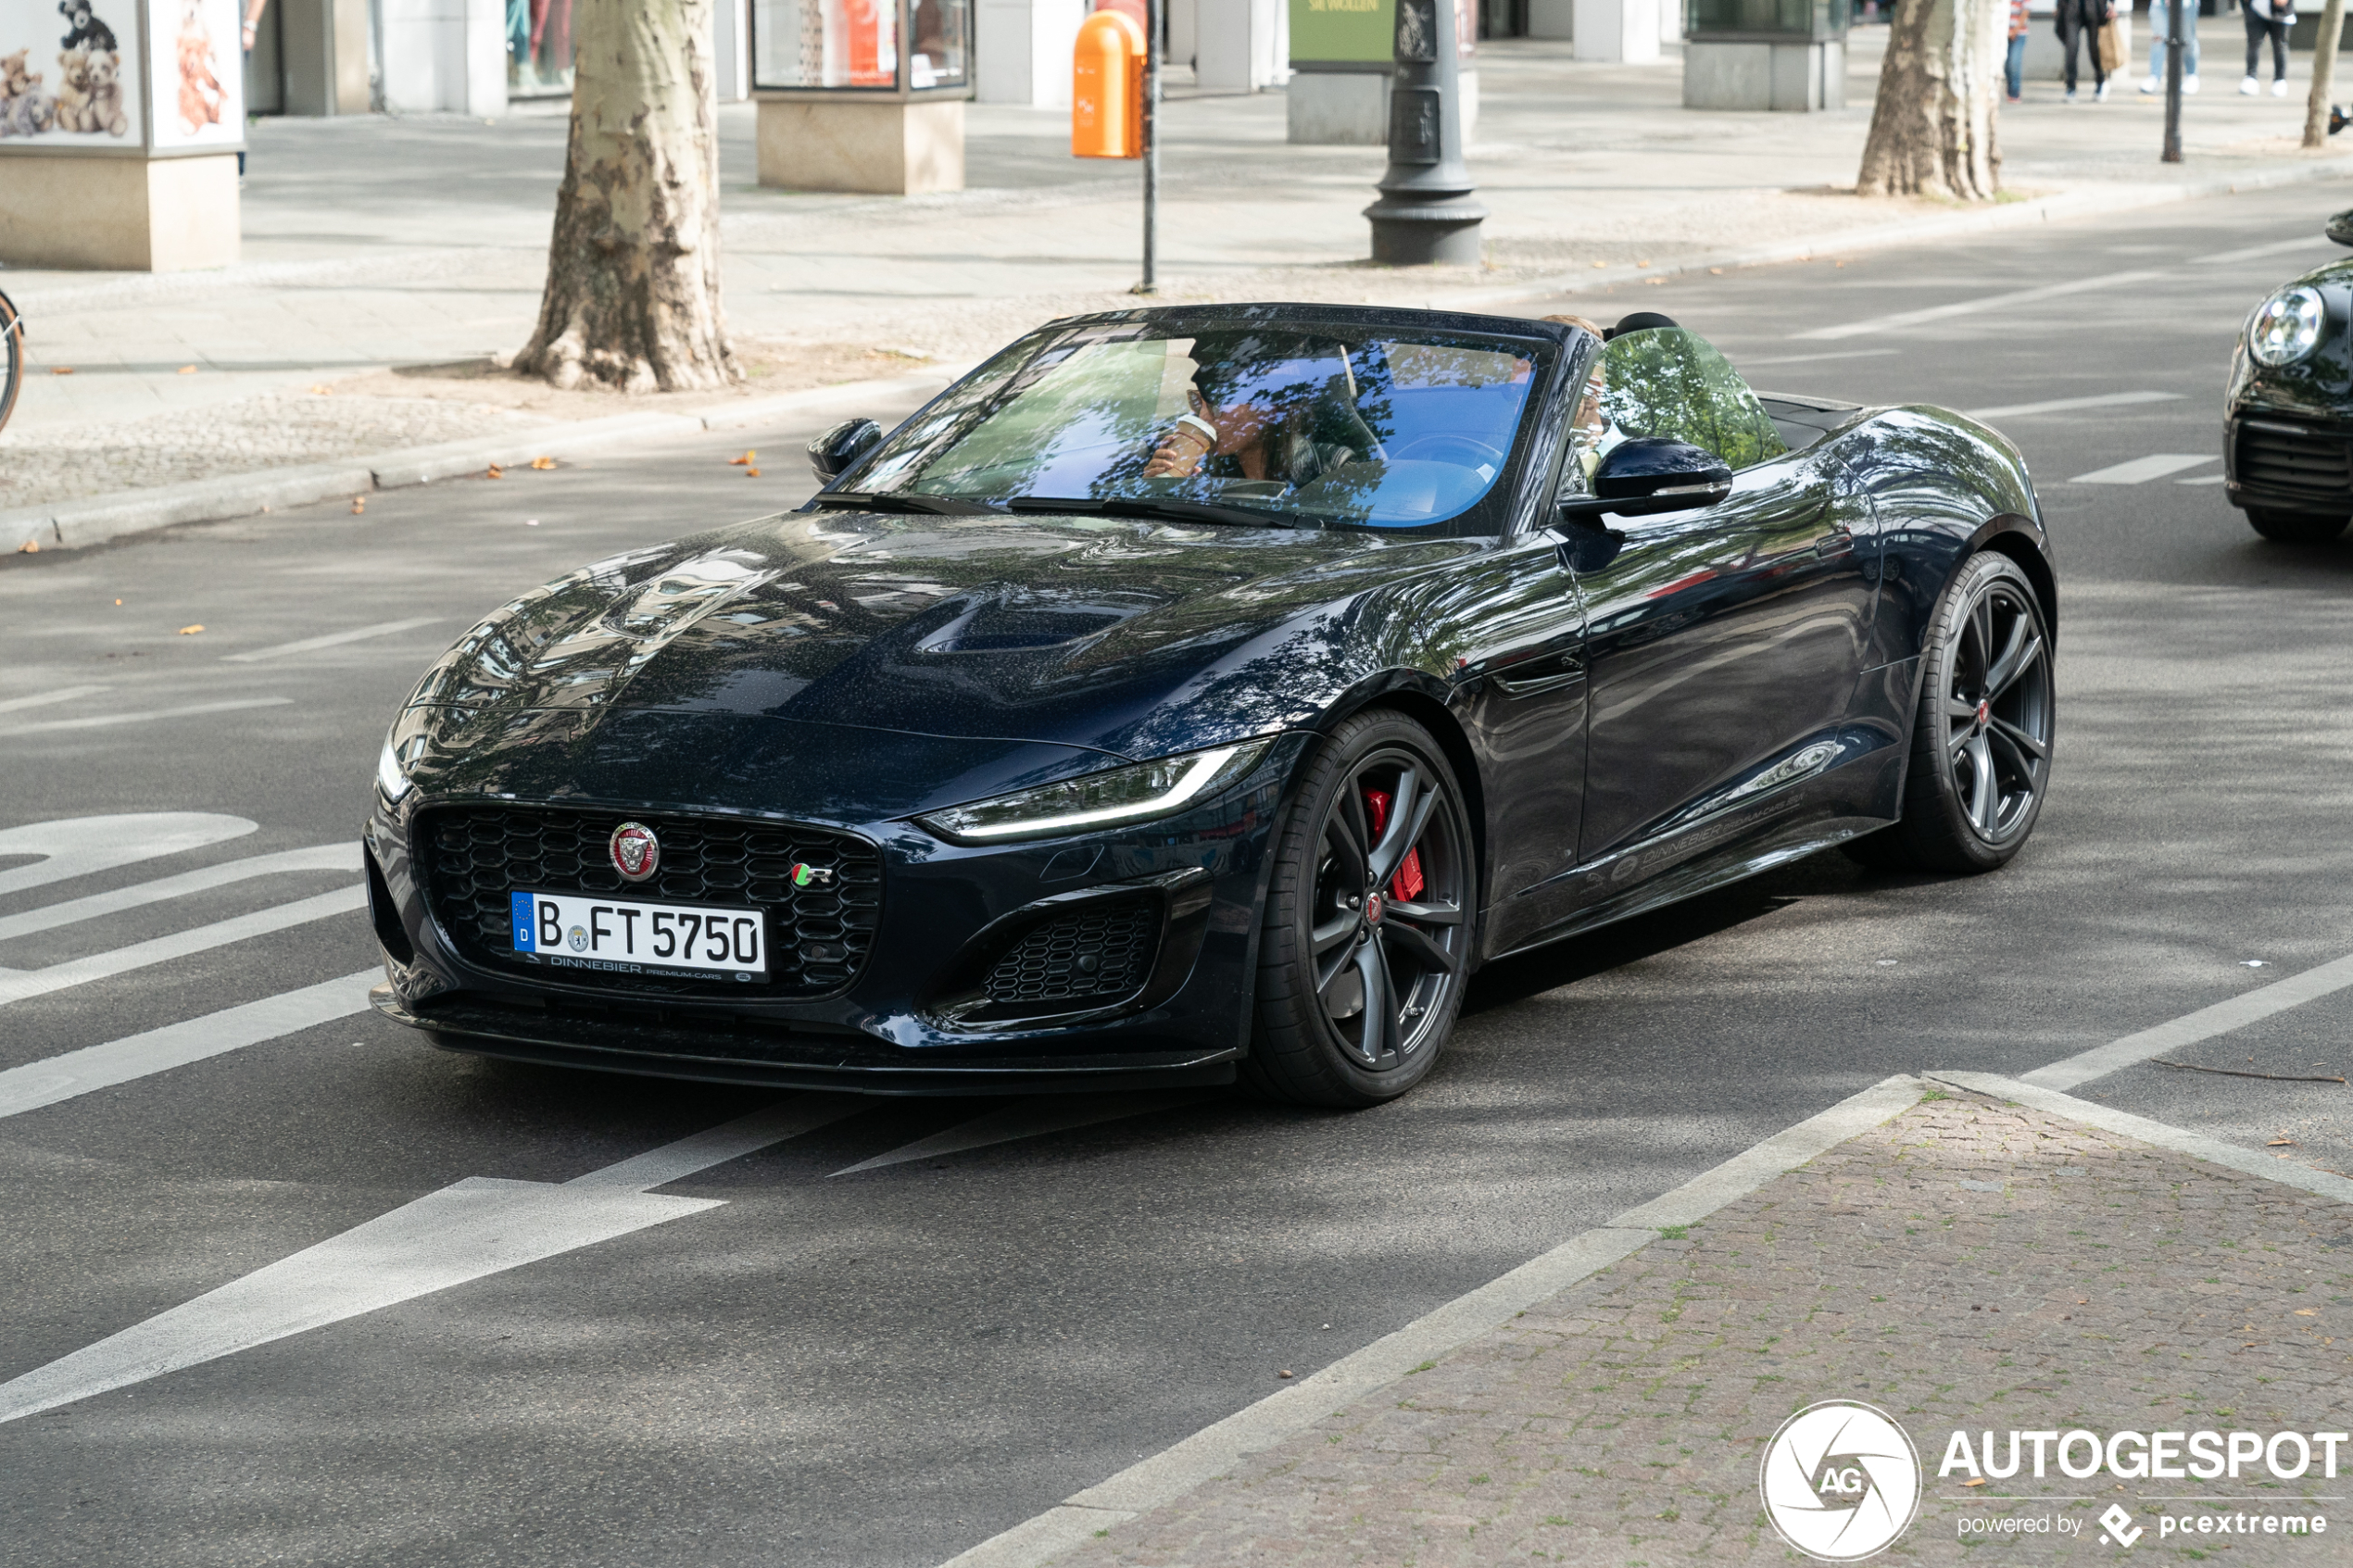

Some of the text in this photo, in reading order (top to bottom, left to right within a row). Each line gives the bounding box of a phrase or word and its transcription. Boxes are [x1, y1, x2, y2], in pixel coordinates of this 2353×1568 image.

[1642, 823, 1722, 864] DINNEBIER
[520, 928, 529, 942] D
[538, 900, 758, 964] B FT 5750
[550, 956, 642, 973] DINNEBIER
[646, 969, 723, 980] PREMIUM-CARS
